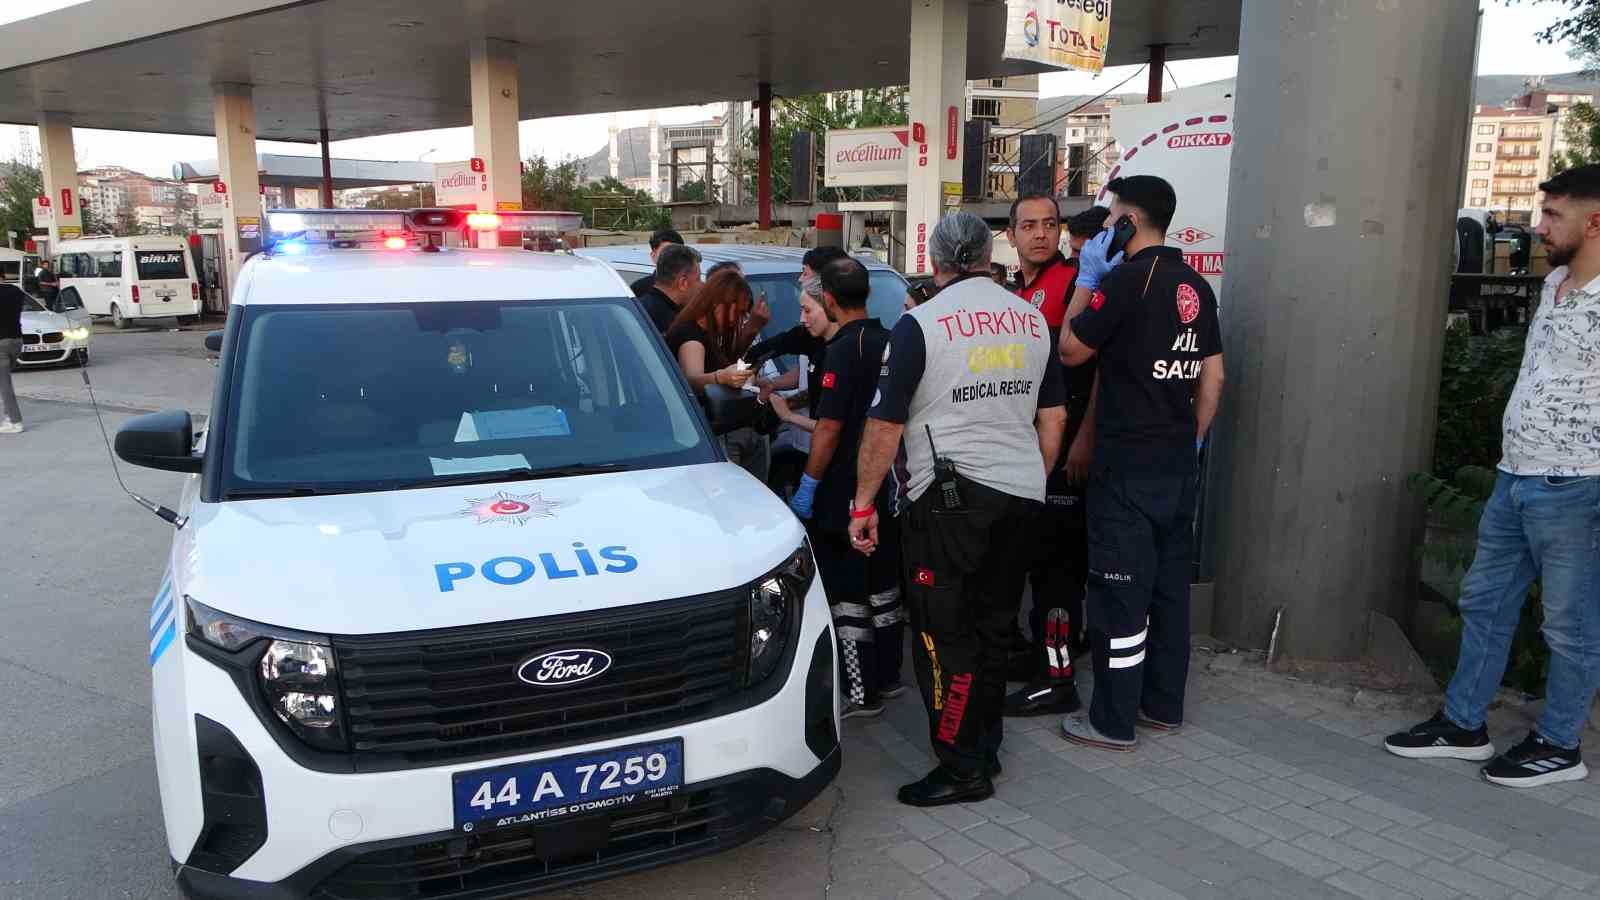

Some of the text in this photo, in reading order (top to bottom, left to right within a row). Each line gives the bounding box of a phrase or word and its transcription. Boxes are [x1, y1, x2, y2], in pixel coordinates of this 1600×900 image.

[836, 142, 902, 162] excellium
[937, 307, 1041, 341] TÜRKİYE
[999, 380, 1032, 397] RESCUE
[434, 541, 638, 593] POLİS
[537, 654, 594, 681] Ford
[470, 752, 667, 811] 44 A 7259
